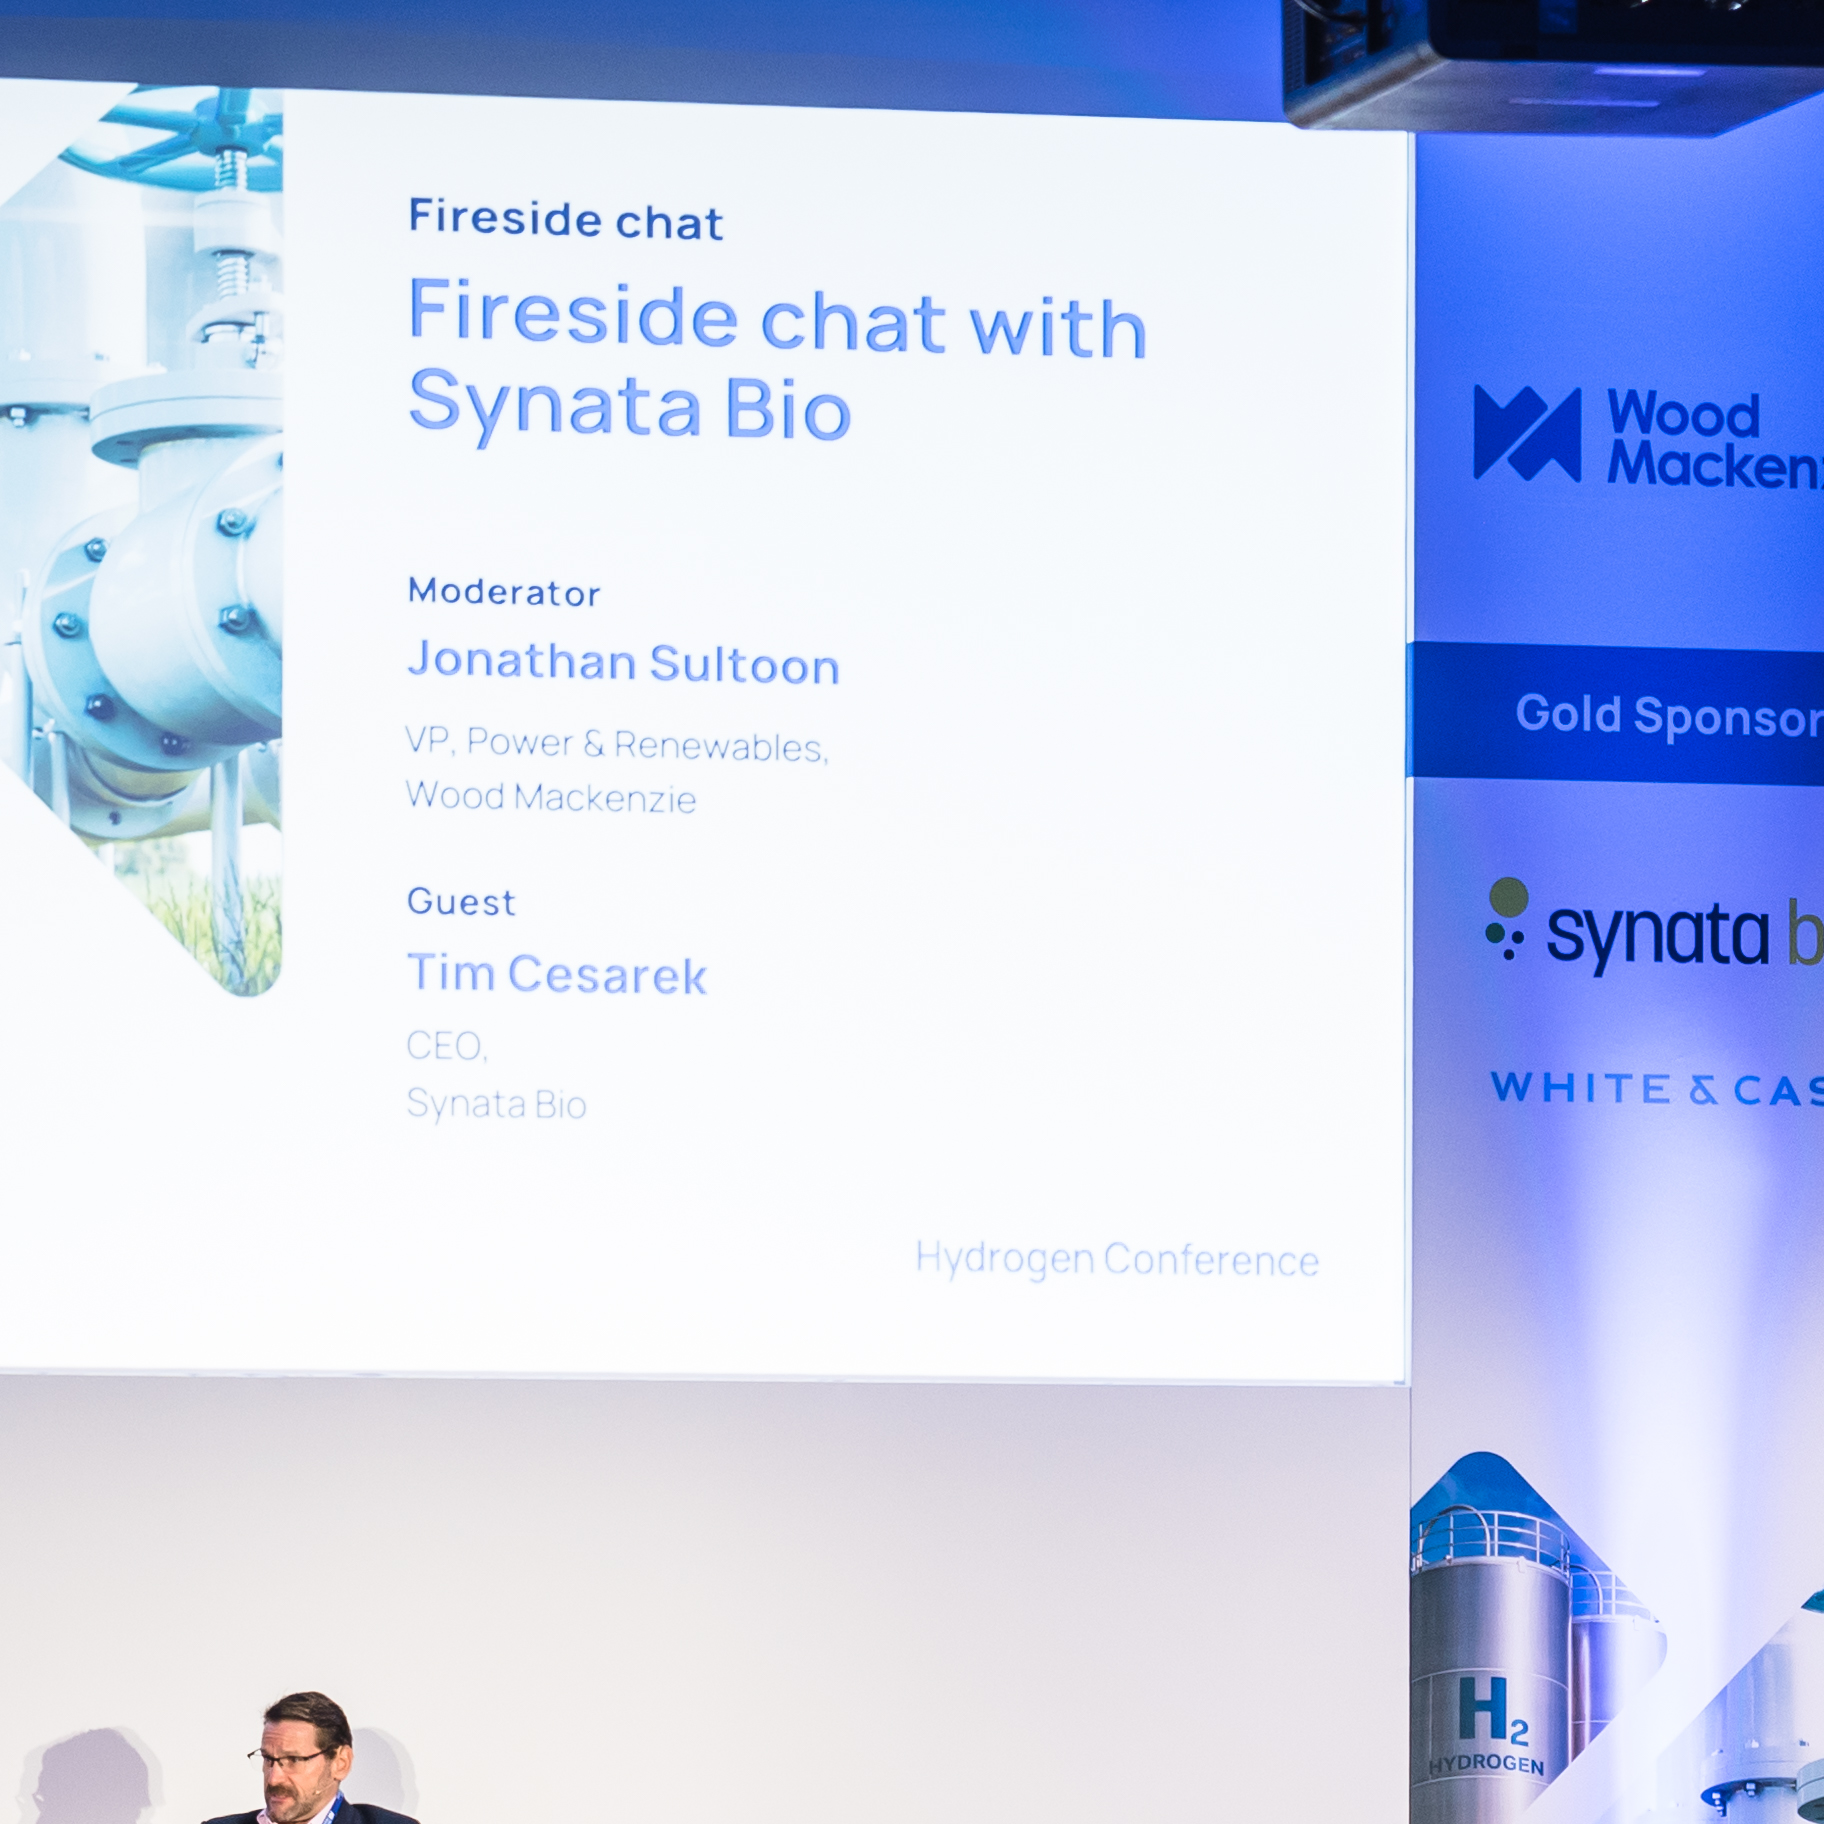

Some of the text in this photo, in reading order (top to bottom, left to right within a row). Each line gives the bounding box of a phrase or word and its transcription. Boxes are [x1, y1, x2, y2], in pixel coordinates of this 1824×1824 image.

[409, 197, 724, 242] Fireside chat
[409, 278, 1146, 359] Fireside chat with
[409, 367, 851, 451] Synata Bio
[1608, 388, 1759, 438] Wood
[408, 576, 600, 609] Moderator
[407, 640, 840, 686] Jonathan Sultoon
[1516, 693, 1621, 732] Gold
[405, 725, 829, 765] VP, Power & Renewables,
[405, 781, 697, 813] Wood Mackenzie
[408, 887, 516, 917] Guest
[1547, 903, 1769, 978] synata
[407, 952, 707, 995] Tim Cesarek
[406, 1029, 488, 1064] CEO,
[407, 1087, 586, 1125] Synata Bio
[1491, 1072, 1670, 1104] WHITE
[1690, 1075, 1719, 1105] &
[916, 1239, 1320, 1282] Hydrogen Conference
[1430, 1754, 1544, 1776] HYDROGEN
